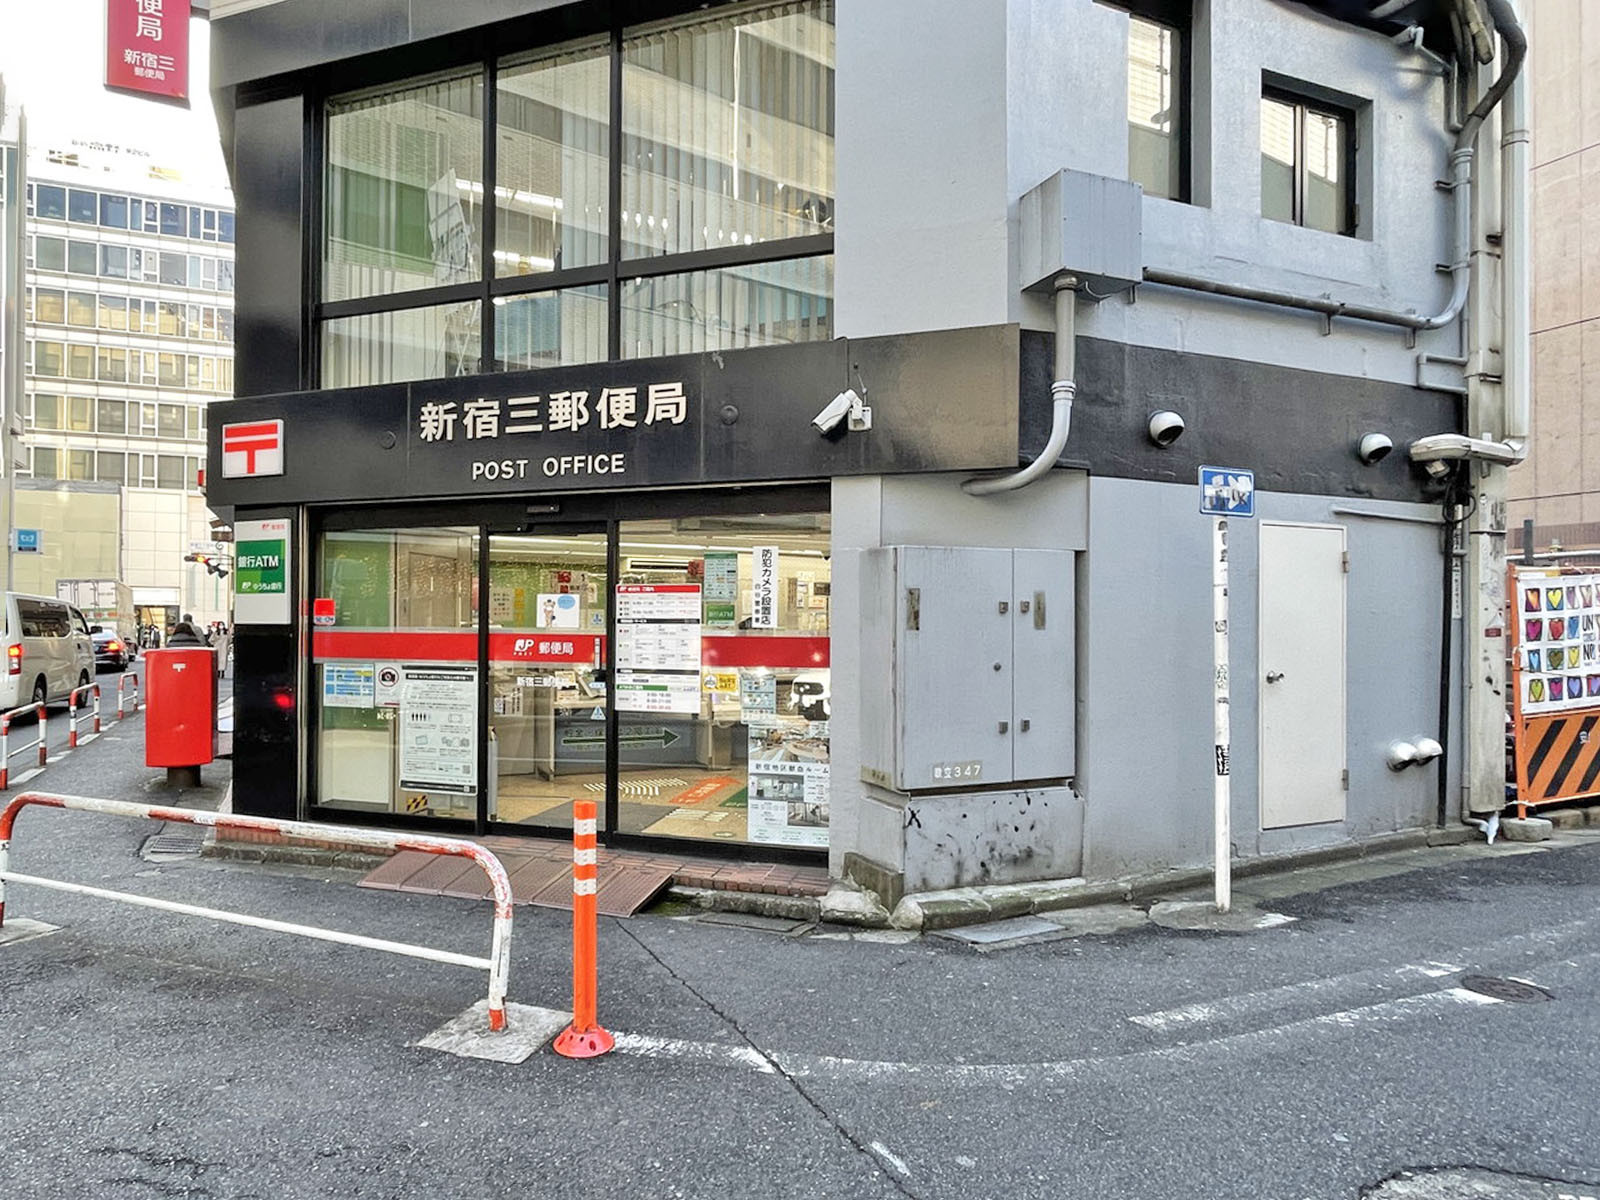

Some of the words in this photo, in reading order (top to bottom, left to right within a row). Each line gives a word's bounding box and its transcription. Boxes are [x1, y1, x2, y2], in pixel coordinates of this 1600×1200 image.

[123, 48, 175, 72] 新宿三
[134, 67, 165, 81] 郵便局
[419, 381, 688, 442] 新宿三郵便局
[471, 459, 529, 481] POST
[543, 453, 625, 476] OFFICE
[237, 555, 279, 568] 銀行ATM
[761, 548, 773, 625] 防犯カメラ設置店
[538, 641, 574, 656] 郵便局
